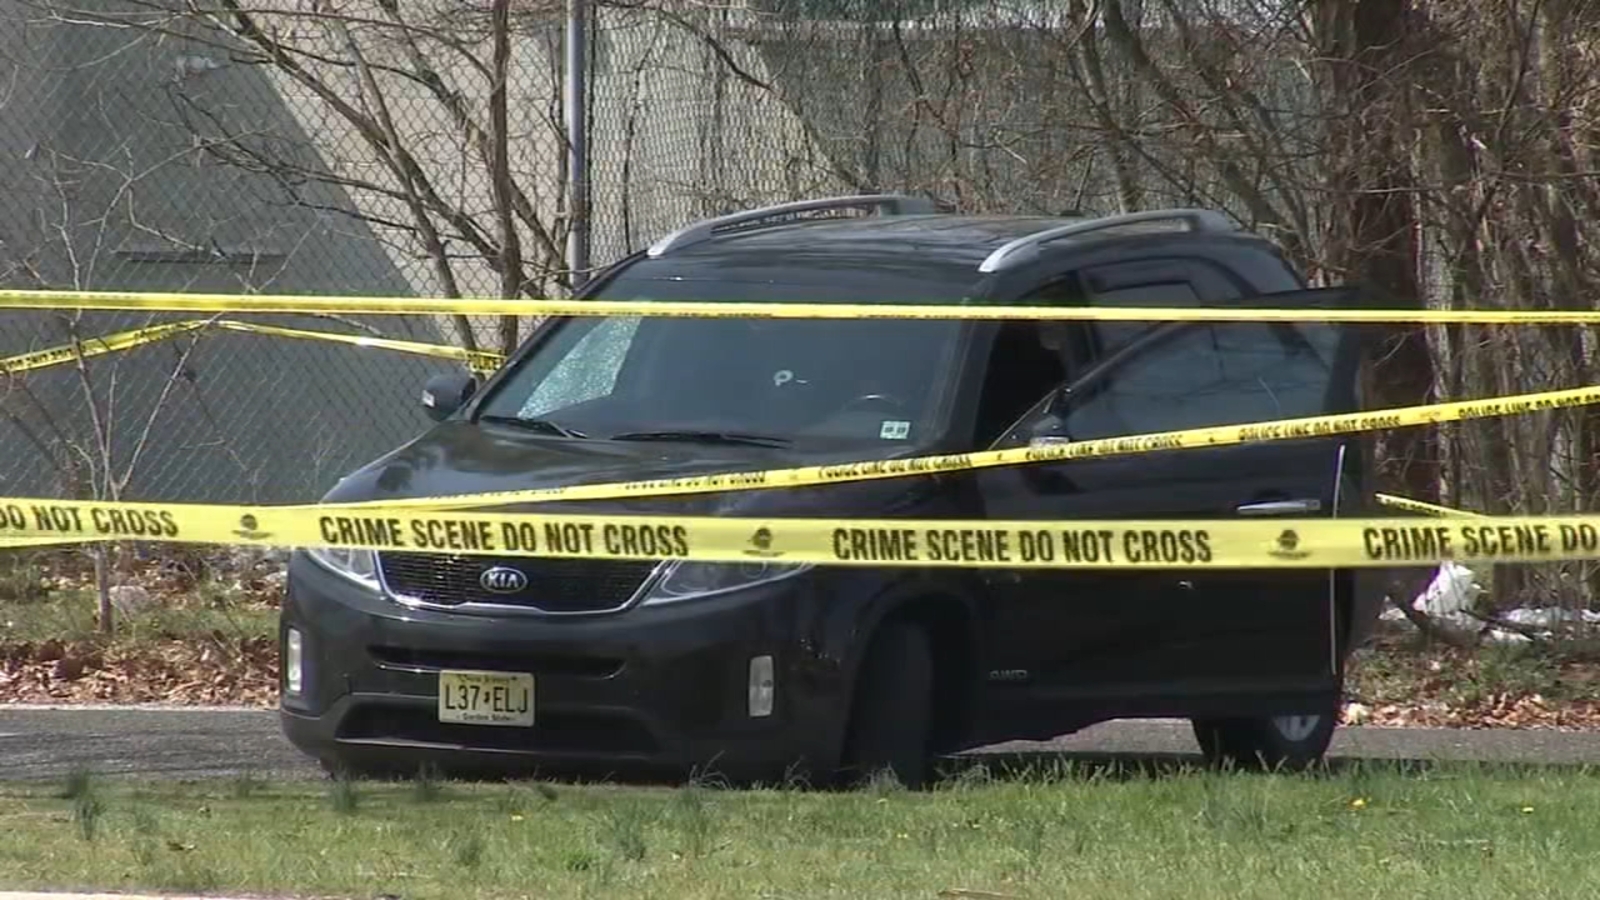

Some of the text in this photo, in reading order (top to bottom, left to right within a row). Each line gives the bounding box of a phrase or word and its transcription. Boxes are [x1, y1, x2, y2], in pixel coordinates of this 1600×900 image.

[31, 504, 85, 532] NOT
[91, 507, 179, 538] CROSS
[319, 516, 689, 556] CRIME SCENE DO NOT CROSS
[832, 527, 1212, 563] CRIME SCENE DO NOT CROSS
[1362, 523, 1599, 561] CRIME SCENE DO
[487, 572, 518, 588] KIA
